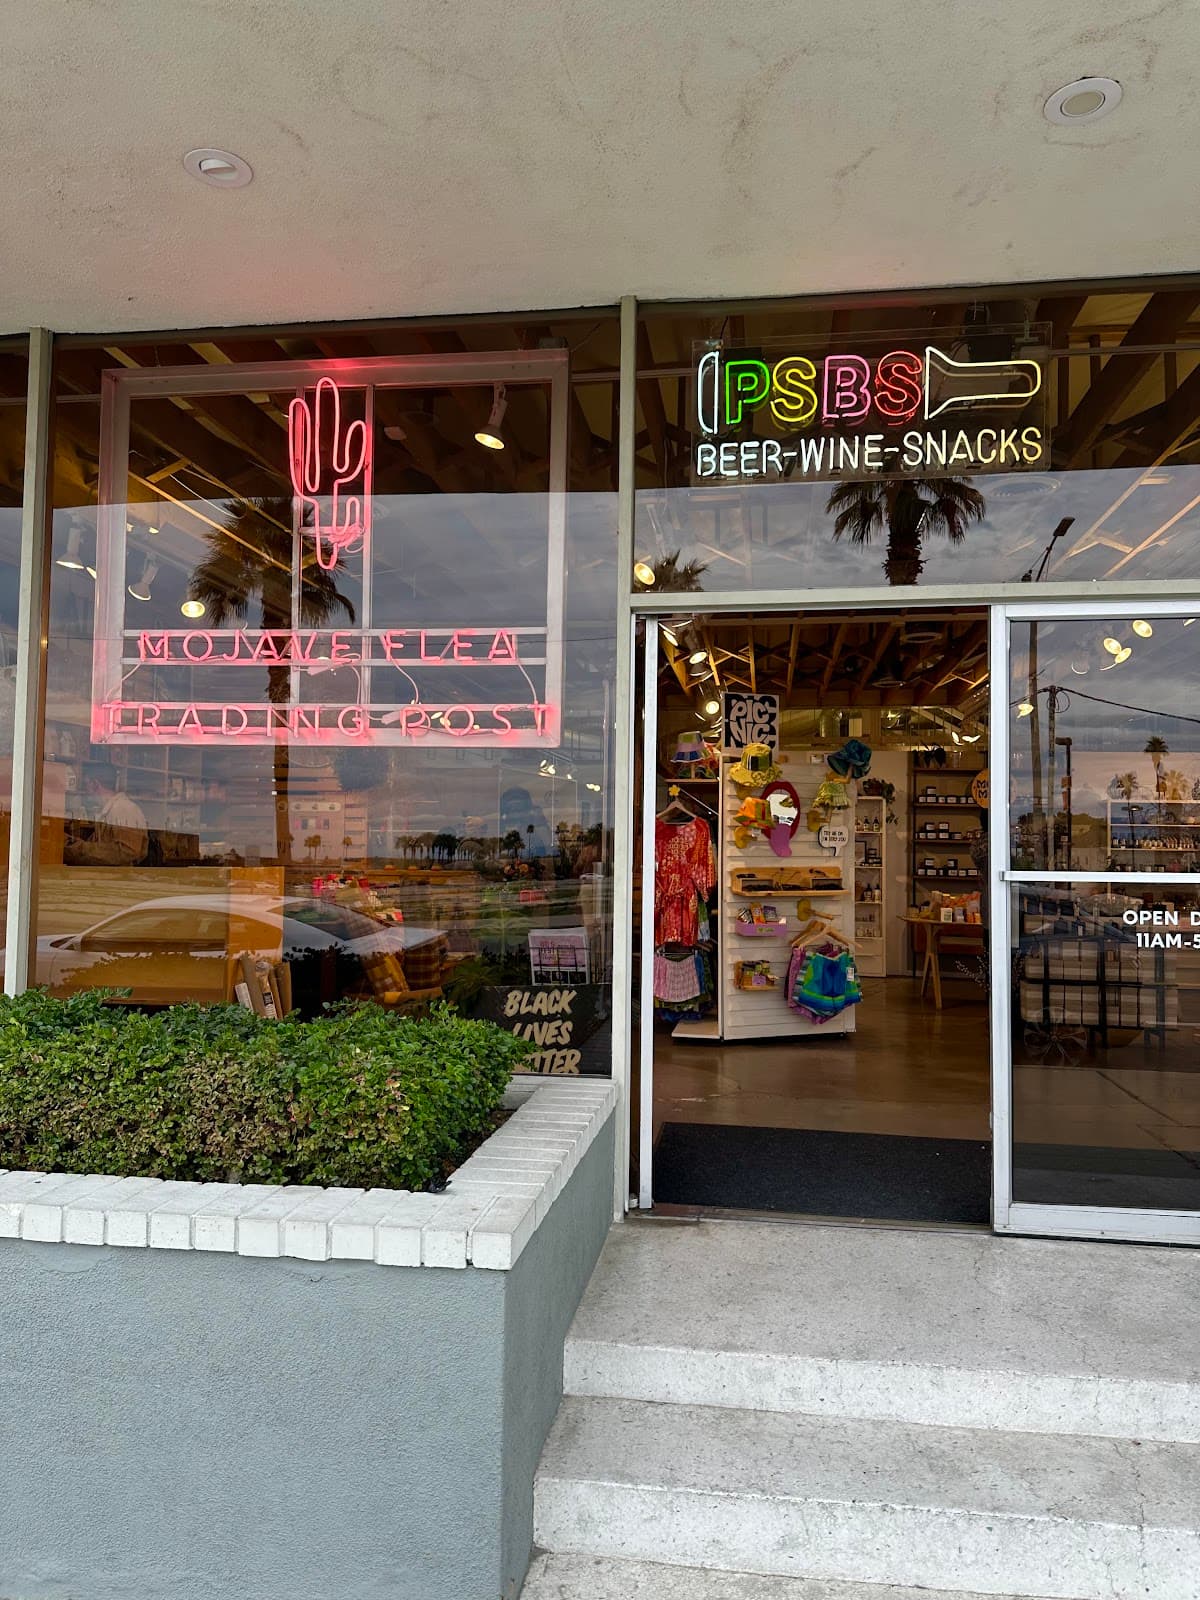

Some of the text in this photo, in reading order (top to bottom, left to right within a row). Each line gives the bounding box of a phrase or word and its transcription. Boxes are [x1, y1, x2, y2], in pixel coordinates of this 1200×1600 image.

[725, 351, 923, 426] PSBS
[137, 629, 517, 663] MOJAVE FLEA
[103, 703, 554, 738] TRADING POST
[1122, 909, 1178, 926] OPEN
[503, 989, 577, 1018] BLACK
